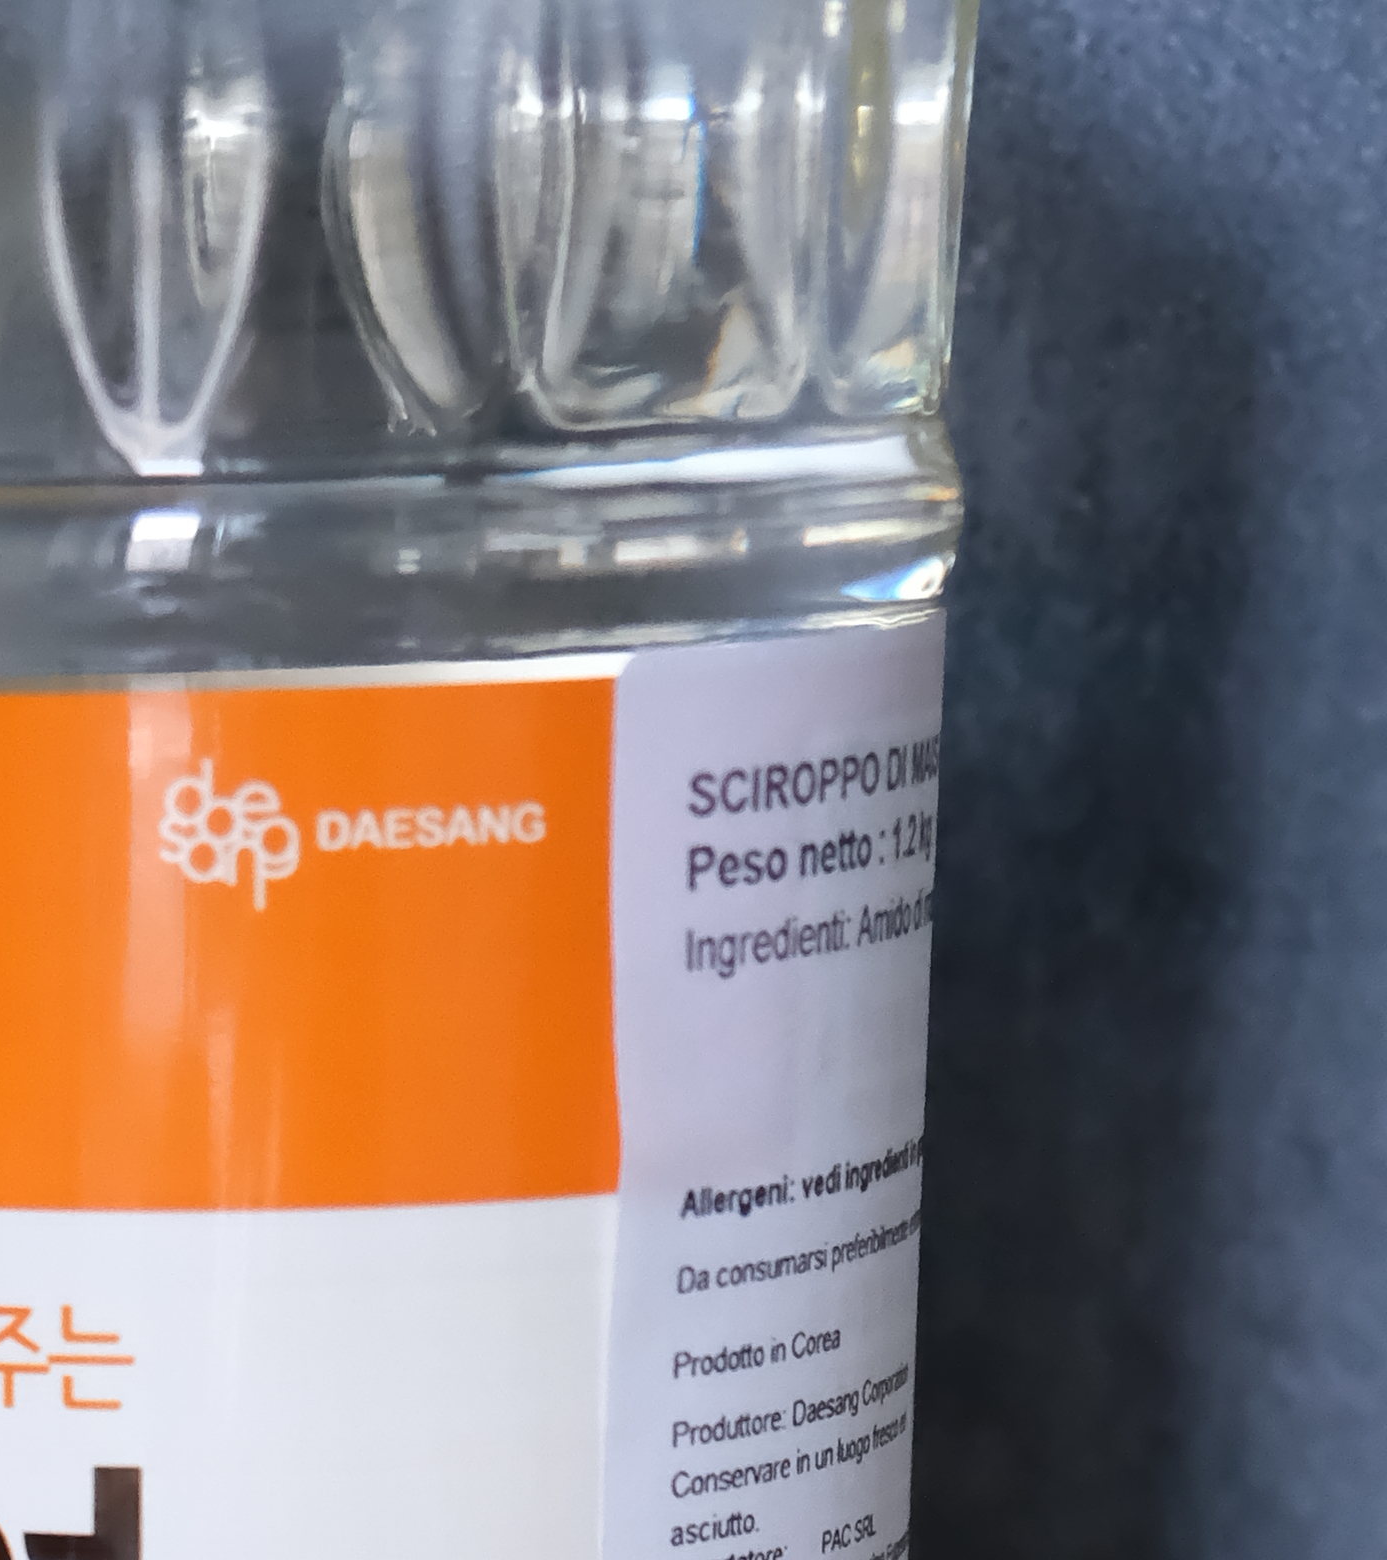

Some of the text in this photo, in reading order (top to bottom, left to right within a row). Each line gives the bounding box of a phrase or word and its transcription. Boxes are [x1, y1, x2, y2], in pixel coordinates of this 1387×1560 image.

[688, 750, 880, 818] SCIROPPO
[885, 745, 908, 792] DI
[314, 799, 548, 853] DAESANG
[688, 844, 789, 890] Peso
[799, 829, 873, 878] netto
[684, 908, 852, 980] Ingredienti:
[857, 903, 911, 948] Amido
[679, 1178, 795, 1220] Allergeni:
[802, 1162, 841, 1199] vedi
[677, 1264, 710, 1295] Da
[715, 1240, 829, 1290] consumarsi
[673, 1328, 842, 1380] Prodotto in Corea
[672, 1408, 786, 1448] Produttore:
[792, 1389, 859, 1428] Daesang
[671, 1456, 791, 1500] Conservare
[795, 1447, 812, 1476] in
[814, 1446, 835, 1472] un
[836, 1436, 872, 1466] luogo
[670, 1511, 760, 1548] asciutto.
[821, 1523, 852, 1555] PAC
[853, 1512, 877, 1544] SRL
